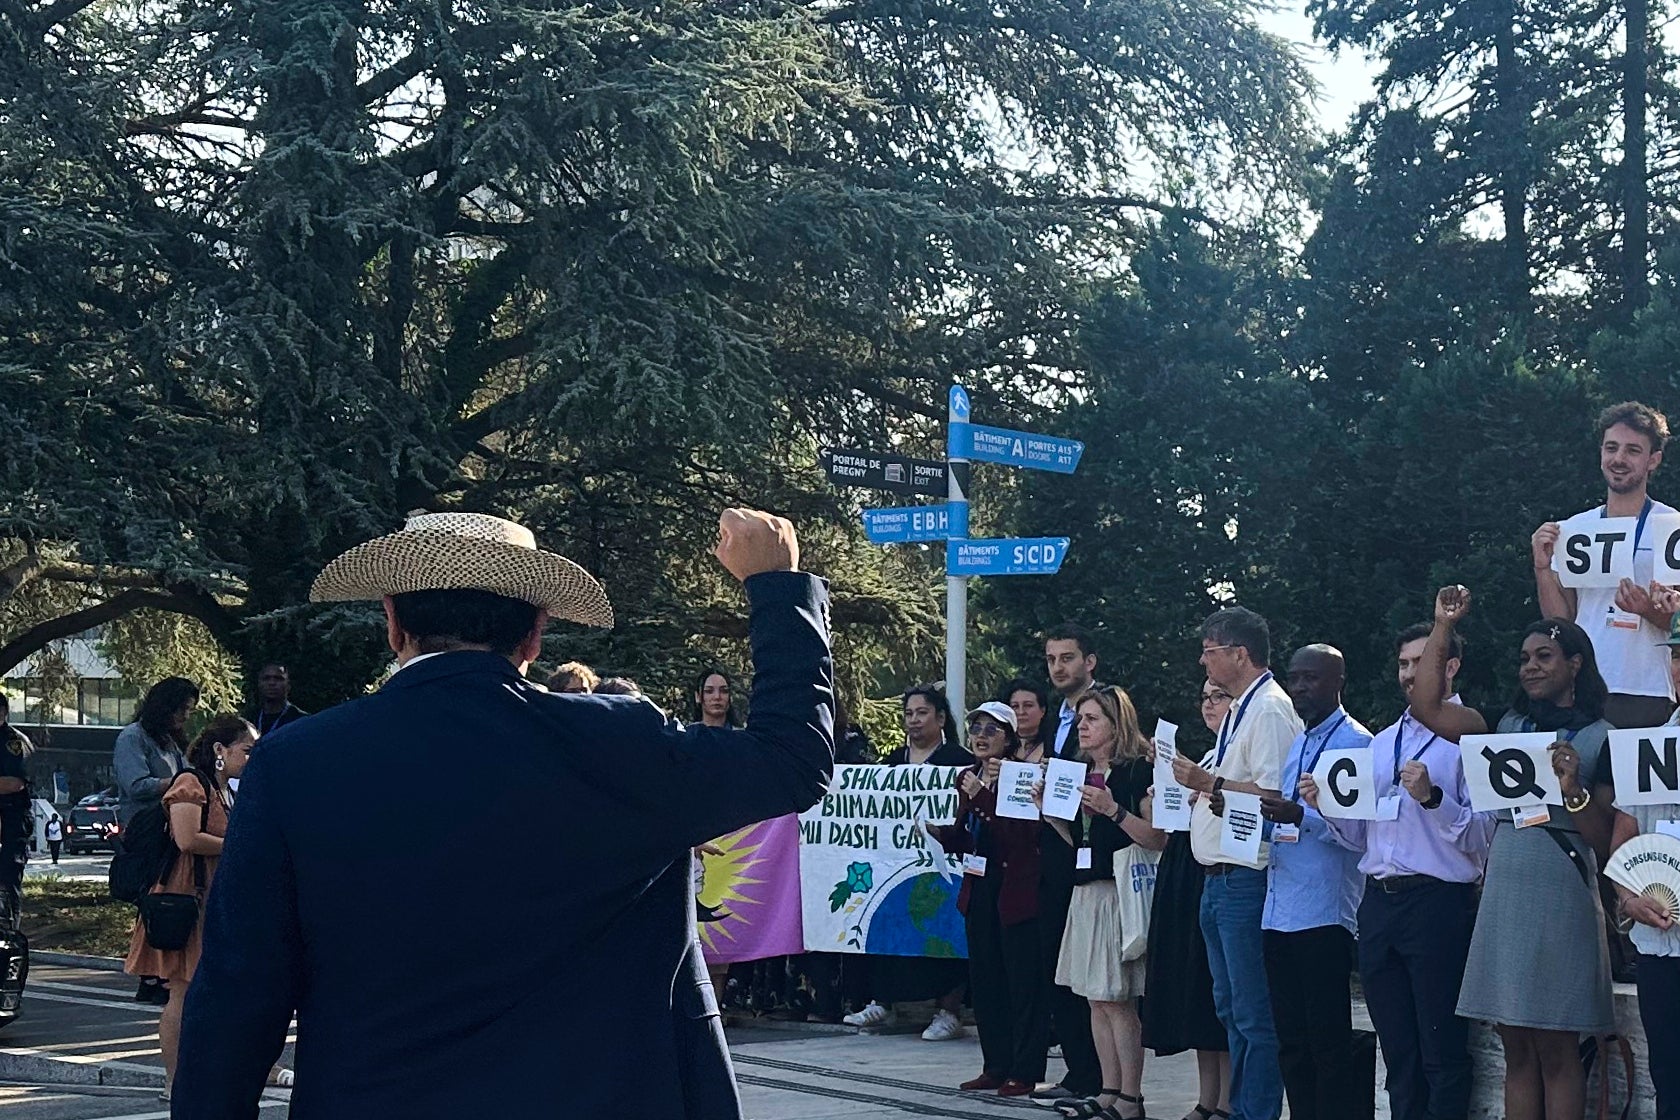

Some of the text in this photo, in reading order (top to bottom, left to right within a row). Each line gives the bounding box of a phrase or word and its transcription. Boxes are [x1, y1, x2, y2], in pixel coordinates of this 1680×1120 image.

[1012, 438, 1024, 457] A
[1028, 440, 1056, 453] PORTES
[1028, 451, 1051, 462] DOORS
[832, 454, 881, 469] PORTAIL DE
[832, 465, 866, 477] PREGNY
[914, 466, 943, 477] SORTIE
[914, 477, 930, 485] EXIT
[913, 512, 921, 531] E
[926, 512, 935, 530] B
[939, 511, 948, 529] H
[958, 544, 1055, 564] BÂTIMENTS S C D
[1566, 533, 1626, 574] ST
[1638, 738, 1678, 792] N
[1328, 758, 1358, 807] C
[829, 823, 878, 849] DASH
[1624, 852, 1668, 872] CONSENSUS
